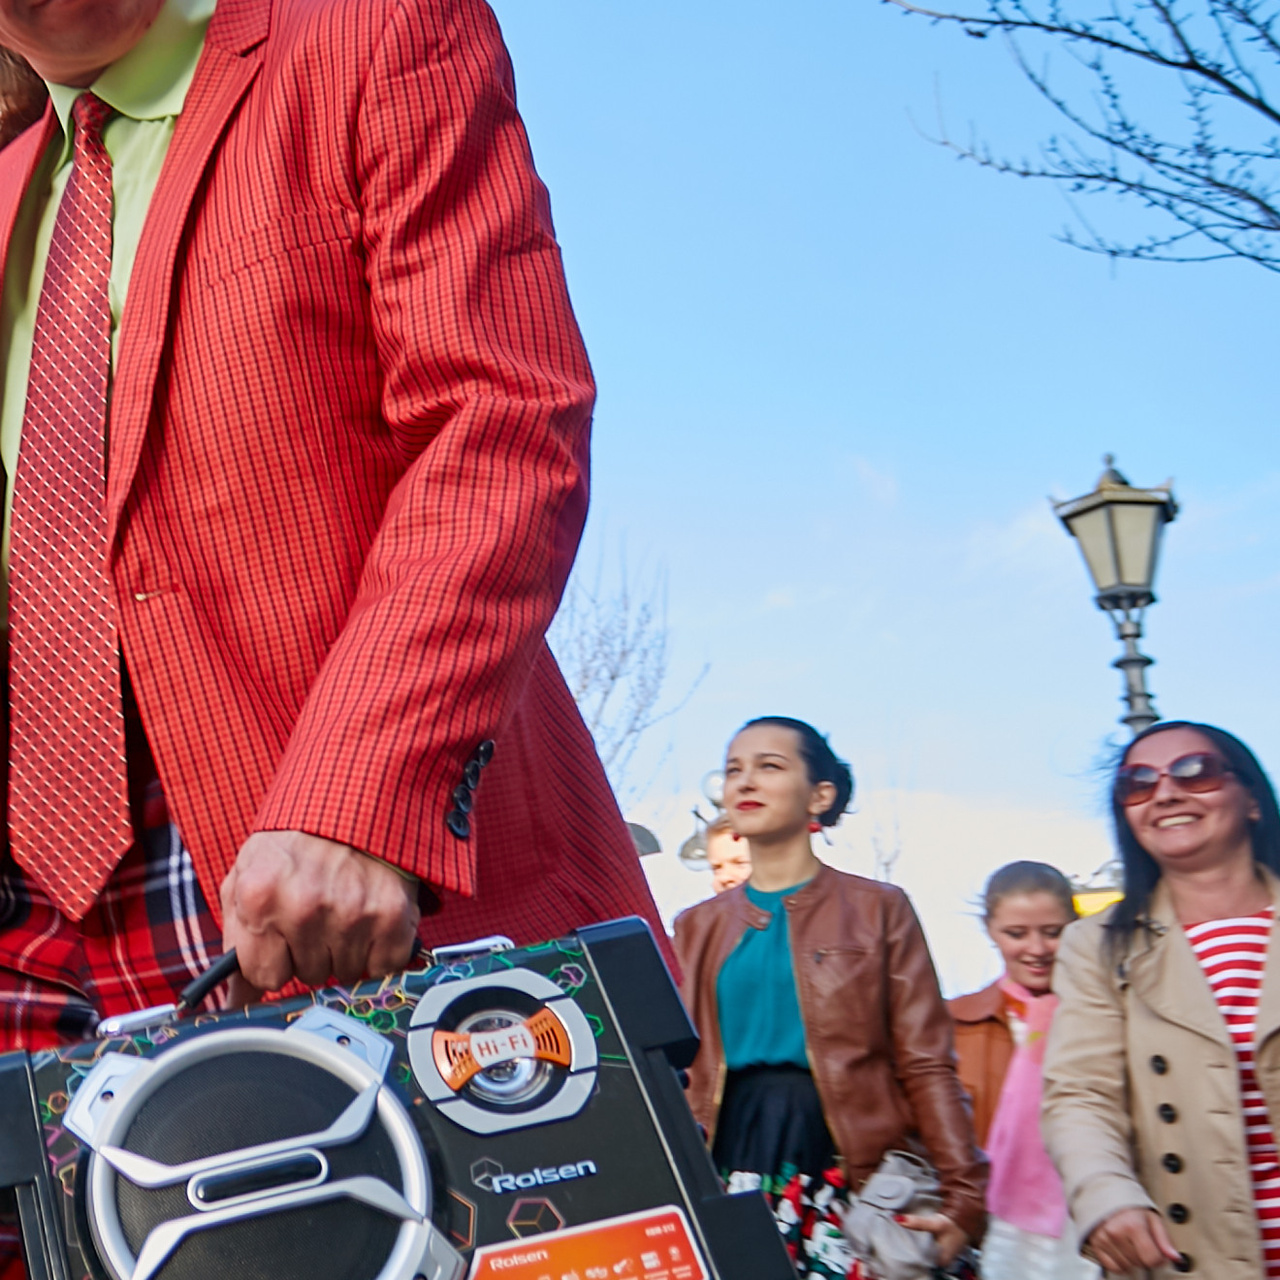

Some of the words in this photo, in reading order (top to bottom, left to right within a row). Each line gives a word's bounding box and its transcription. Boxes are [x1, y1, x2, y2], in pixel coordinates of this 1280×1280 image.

[477, 1033, 529, 1058] Hi-Fi
[491, 1159, 598, 1194] Rolsen
[490, 1248, 549, 1272] Rolsen
